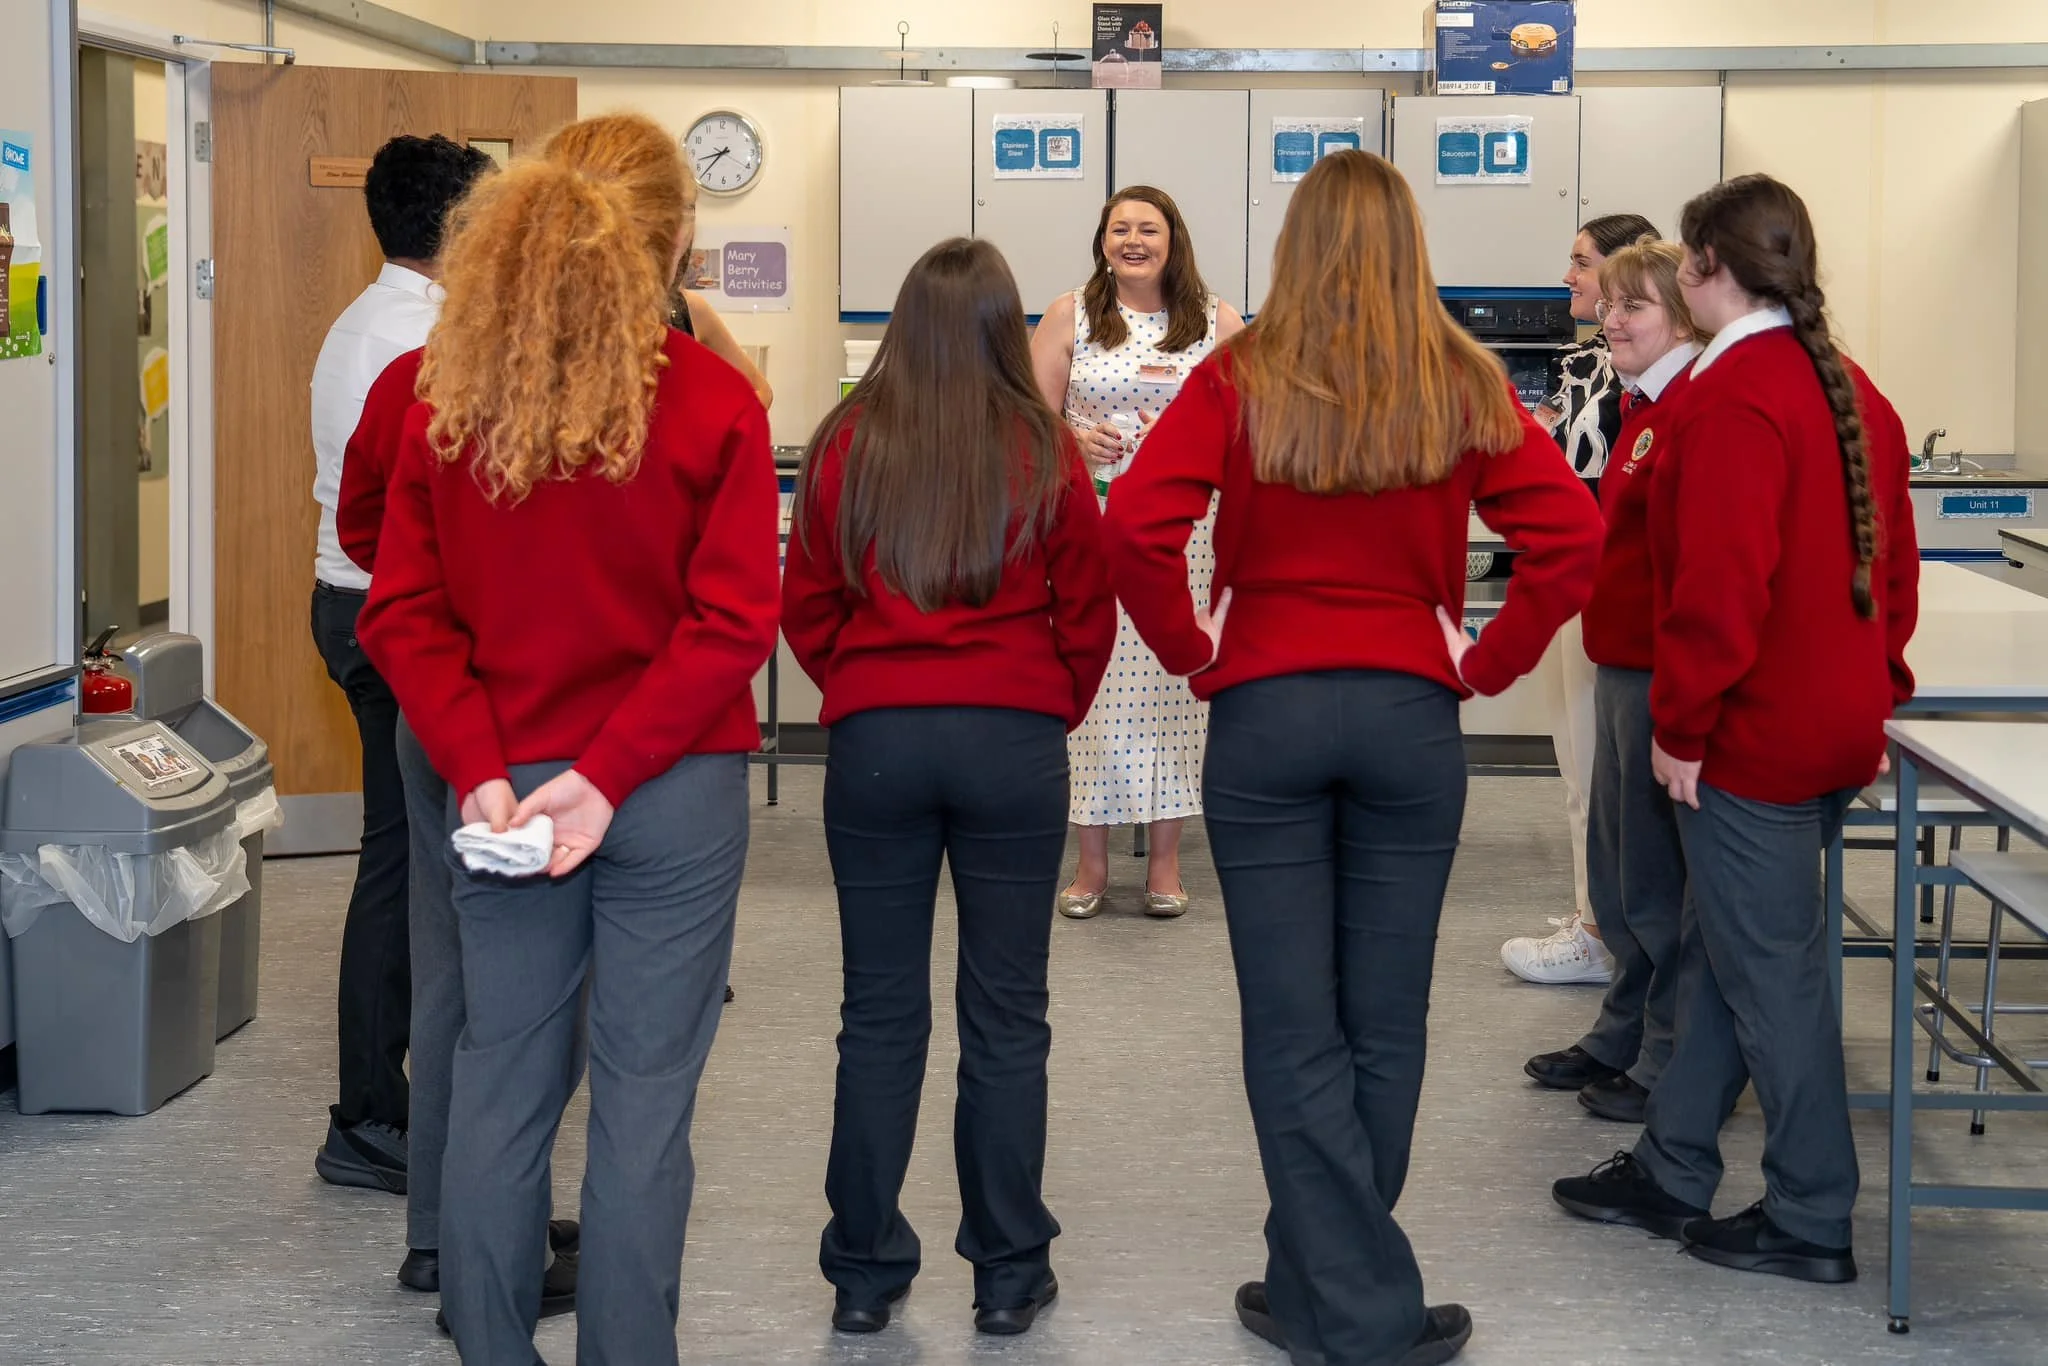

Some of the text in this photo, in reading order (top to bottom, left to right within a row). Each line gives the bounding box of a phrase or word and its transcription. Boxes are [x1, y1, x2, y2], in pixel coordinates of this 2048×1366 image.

[719, 120, 727, 130] 12
[695, 136, 703, 145] 10
[1441, 150, 1477, 158] Saucepans
[727, 250, 757, 263] Mary
[727, 264, 760, 278] Berry
[727, 279, 783, 290] Activities
[1969, 501, 1999, 509] Unit 11
